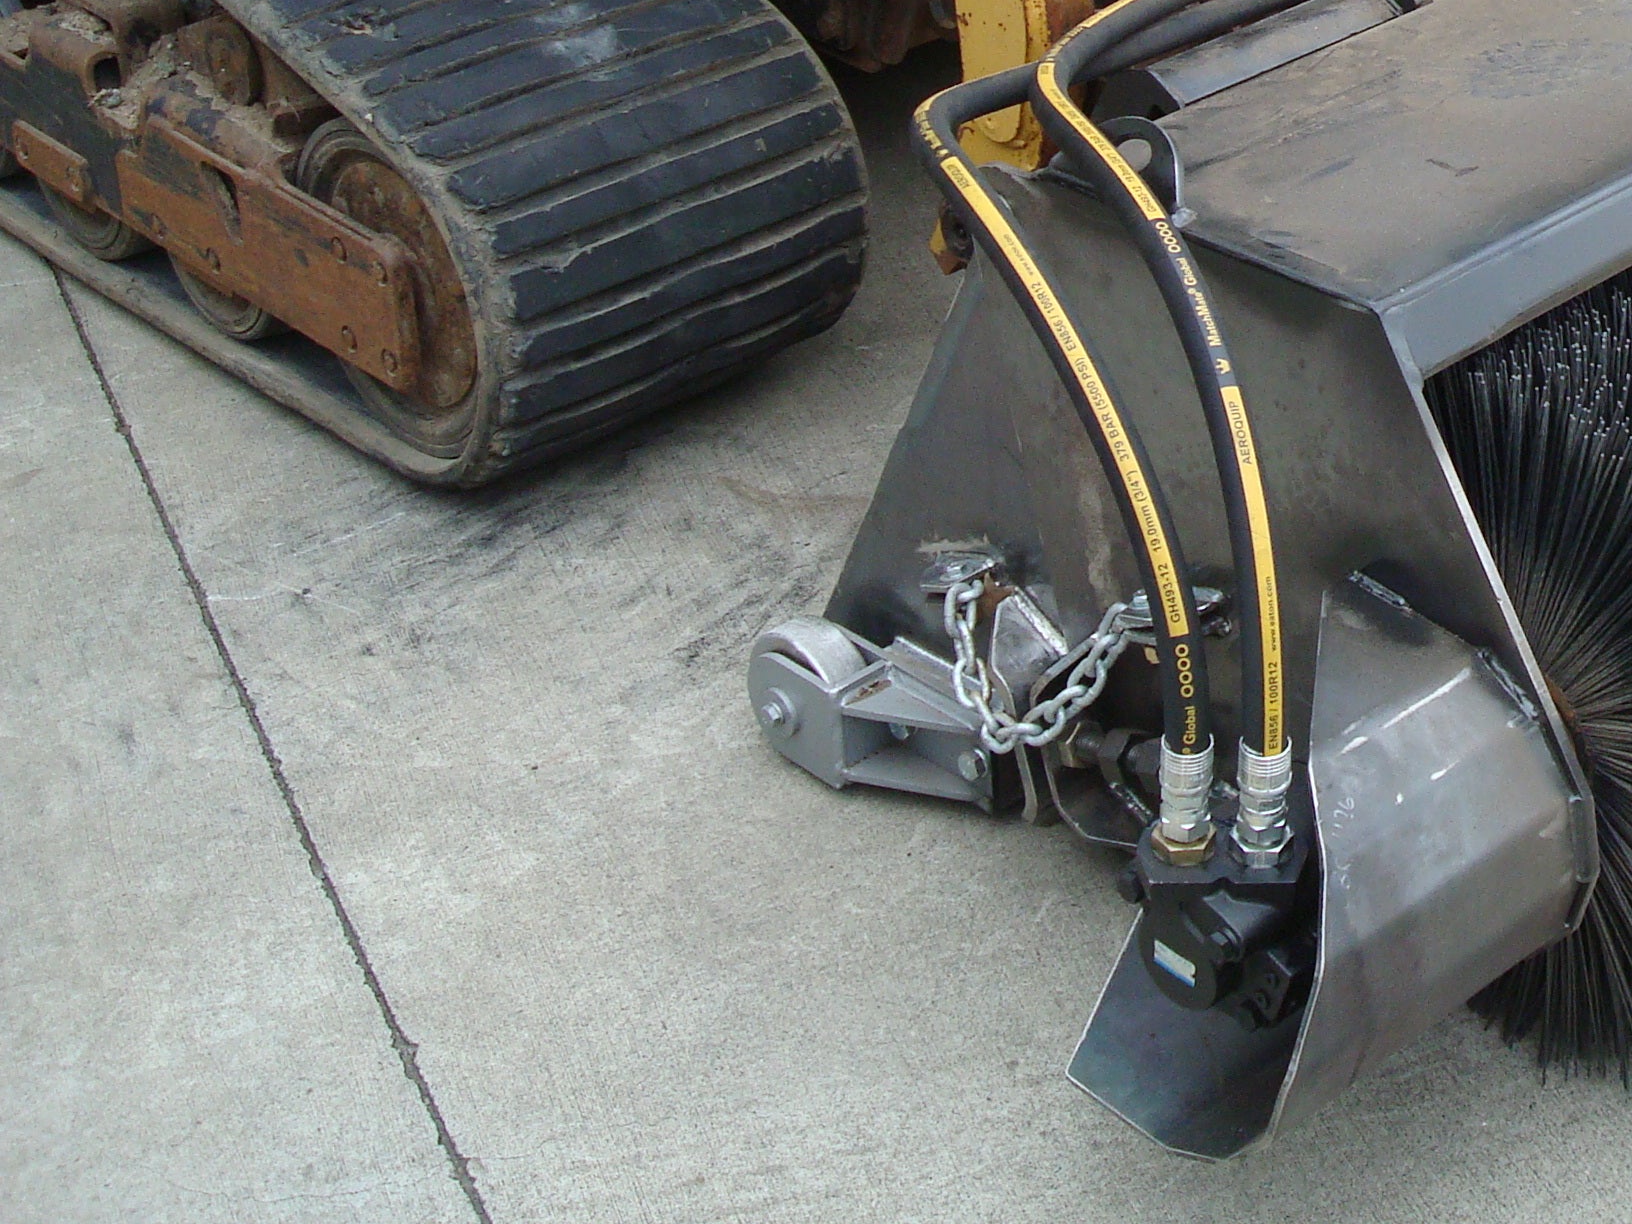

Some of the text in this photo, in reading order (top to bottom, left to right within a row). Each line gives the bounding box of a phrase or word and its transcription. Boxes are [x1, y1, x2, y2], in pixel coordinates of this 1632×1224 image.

[1031, 281, 1055, 314] 100R12
[1052, 319, 1077, 352] EN856
[1074, 357, 1092, 380] PSI)
[1086, 380, 1109, 411] (5500
[1101, 412, 1120, 439] BAR
[1228, 400, 1252, 465] AEROQUIP
[1113, 441, 1130, 462] 379
[1141, 504, 1162, 553] 19.0mm
[1158, 562, 1181, 624] GH493-12
[1267, 575, 1278, 653] www.eaton.com
[1268, 660, 1279, 704] 100R12
[1182, 705, 1197, 745] Global
[1268, 713, 1279, 752] EN856
